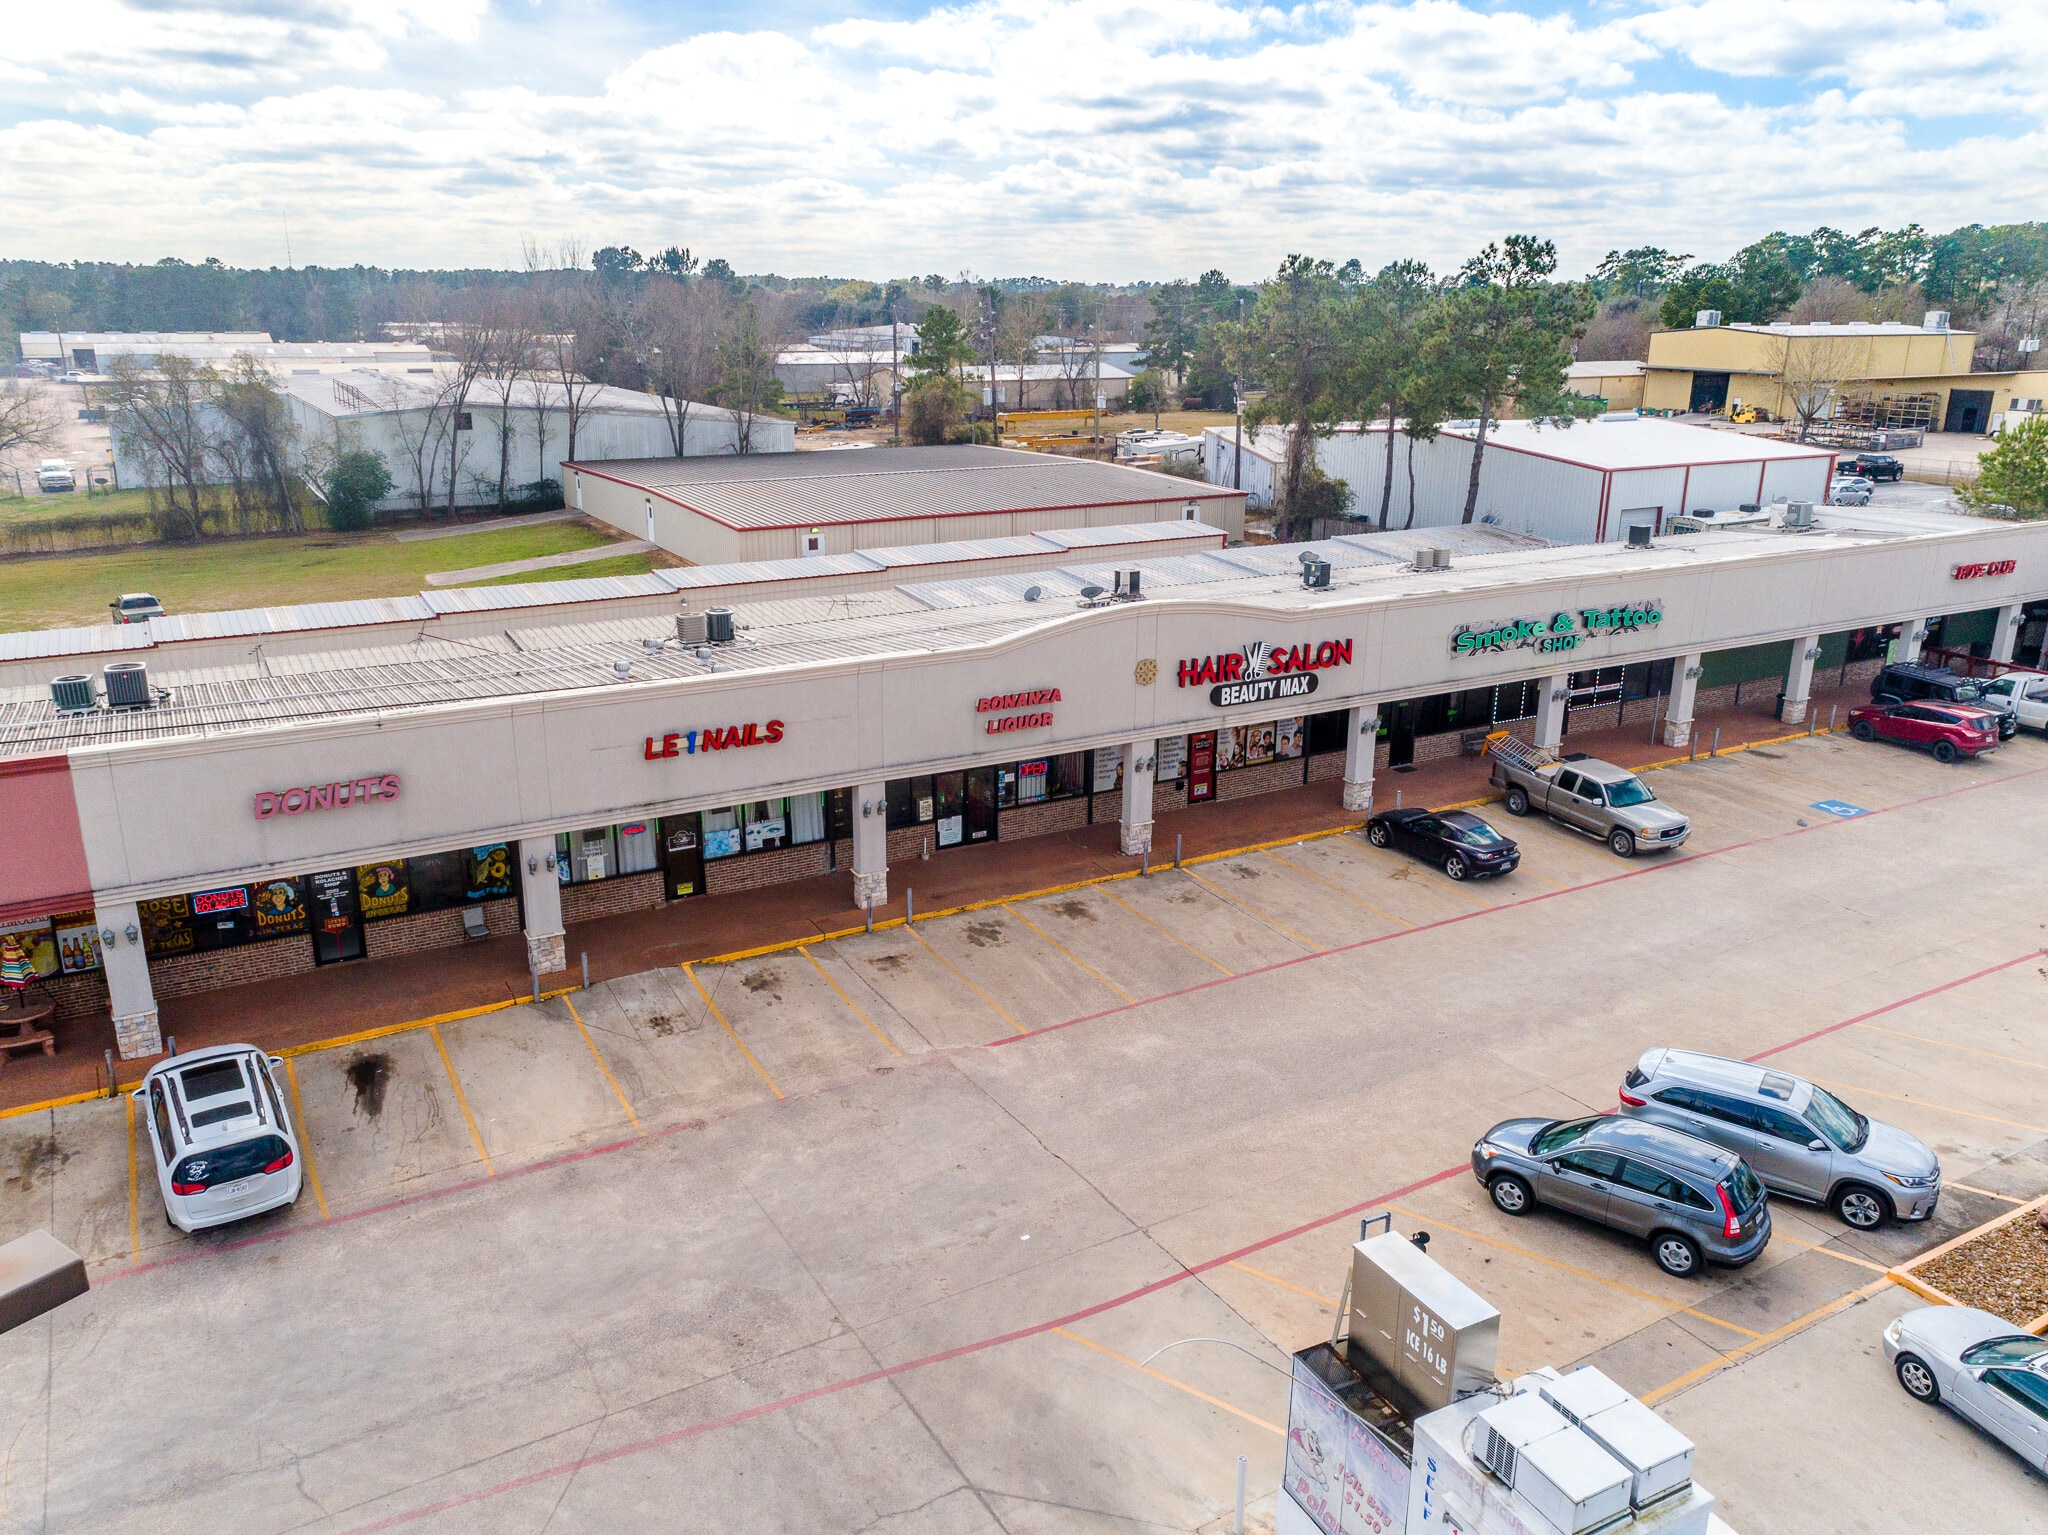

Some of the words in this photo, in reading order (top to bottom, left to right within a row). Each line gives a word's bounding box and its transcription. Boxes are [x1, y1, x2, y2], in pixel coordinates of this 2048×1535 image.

[1455, 620, 1547, 652] Smoke
[1552, 612, 1574, 634] &
[1581, 607, 1662, 630] Tattoo
[1541, 635, 1583, 654] SHOP
[1178, 653, 1244, 688] HAIR
[1267, 638, 1353, 676] SALON
[977, 687, 1062, 713] BONANZA
[1220, 680, 1275, 706] BEAUTY
[1279, 675, 1310, 698] MAX
[987, 711, 1054, 735] LIQUOR
[644, 733, 680, 761] LE
[701, 719, 785, 753] NAILS
[1020, 762, 1047, 777] OPEN
[254, 773, 401, 821] DONUTS
[314, 871, 341, 881] DONUTS
[196, 889, 244, 905] DONUTS
[196, 898, 246, 914] KOLACHES
[361, 886, 408, 910] DONUTS
[255, 904, 306, 927] DONUTS
[1406, 1328, 1421, 1353] ICE
[1422, 1341, 1434, 1364] 16
[1435, 1353, 1448, 1376] LB
[1308, 1382, 1336, 1417] ICE
[1350, 1425, 1407, 1487] HIELO
[1423, 1456, 1437, 1520] SELF
[1366, 1494, 1393, 1527] Bag
